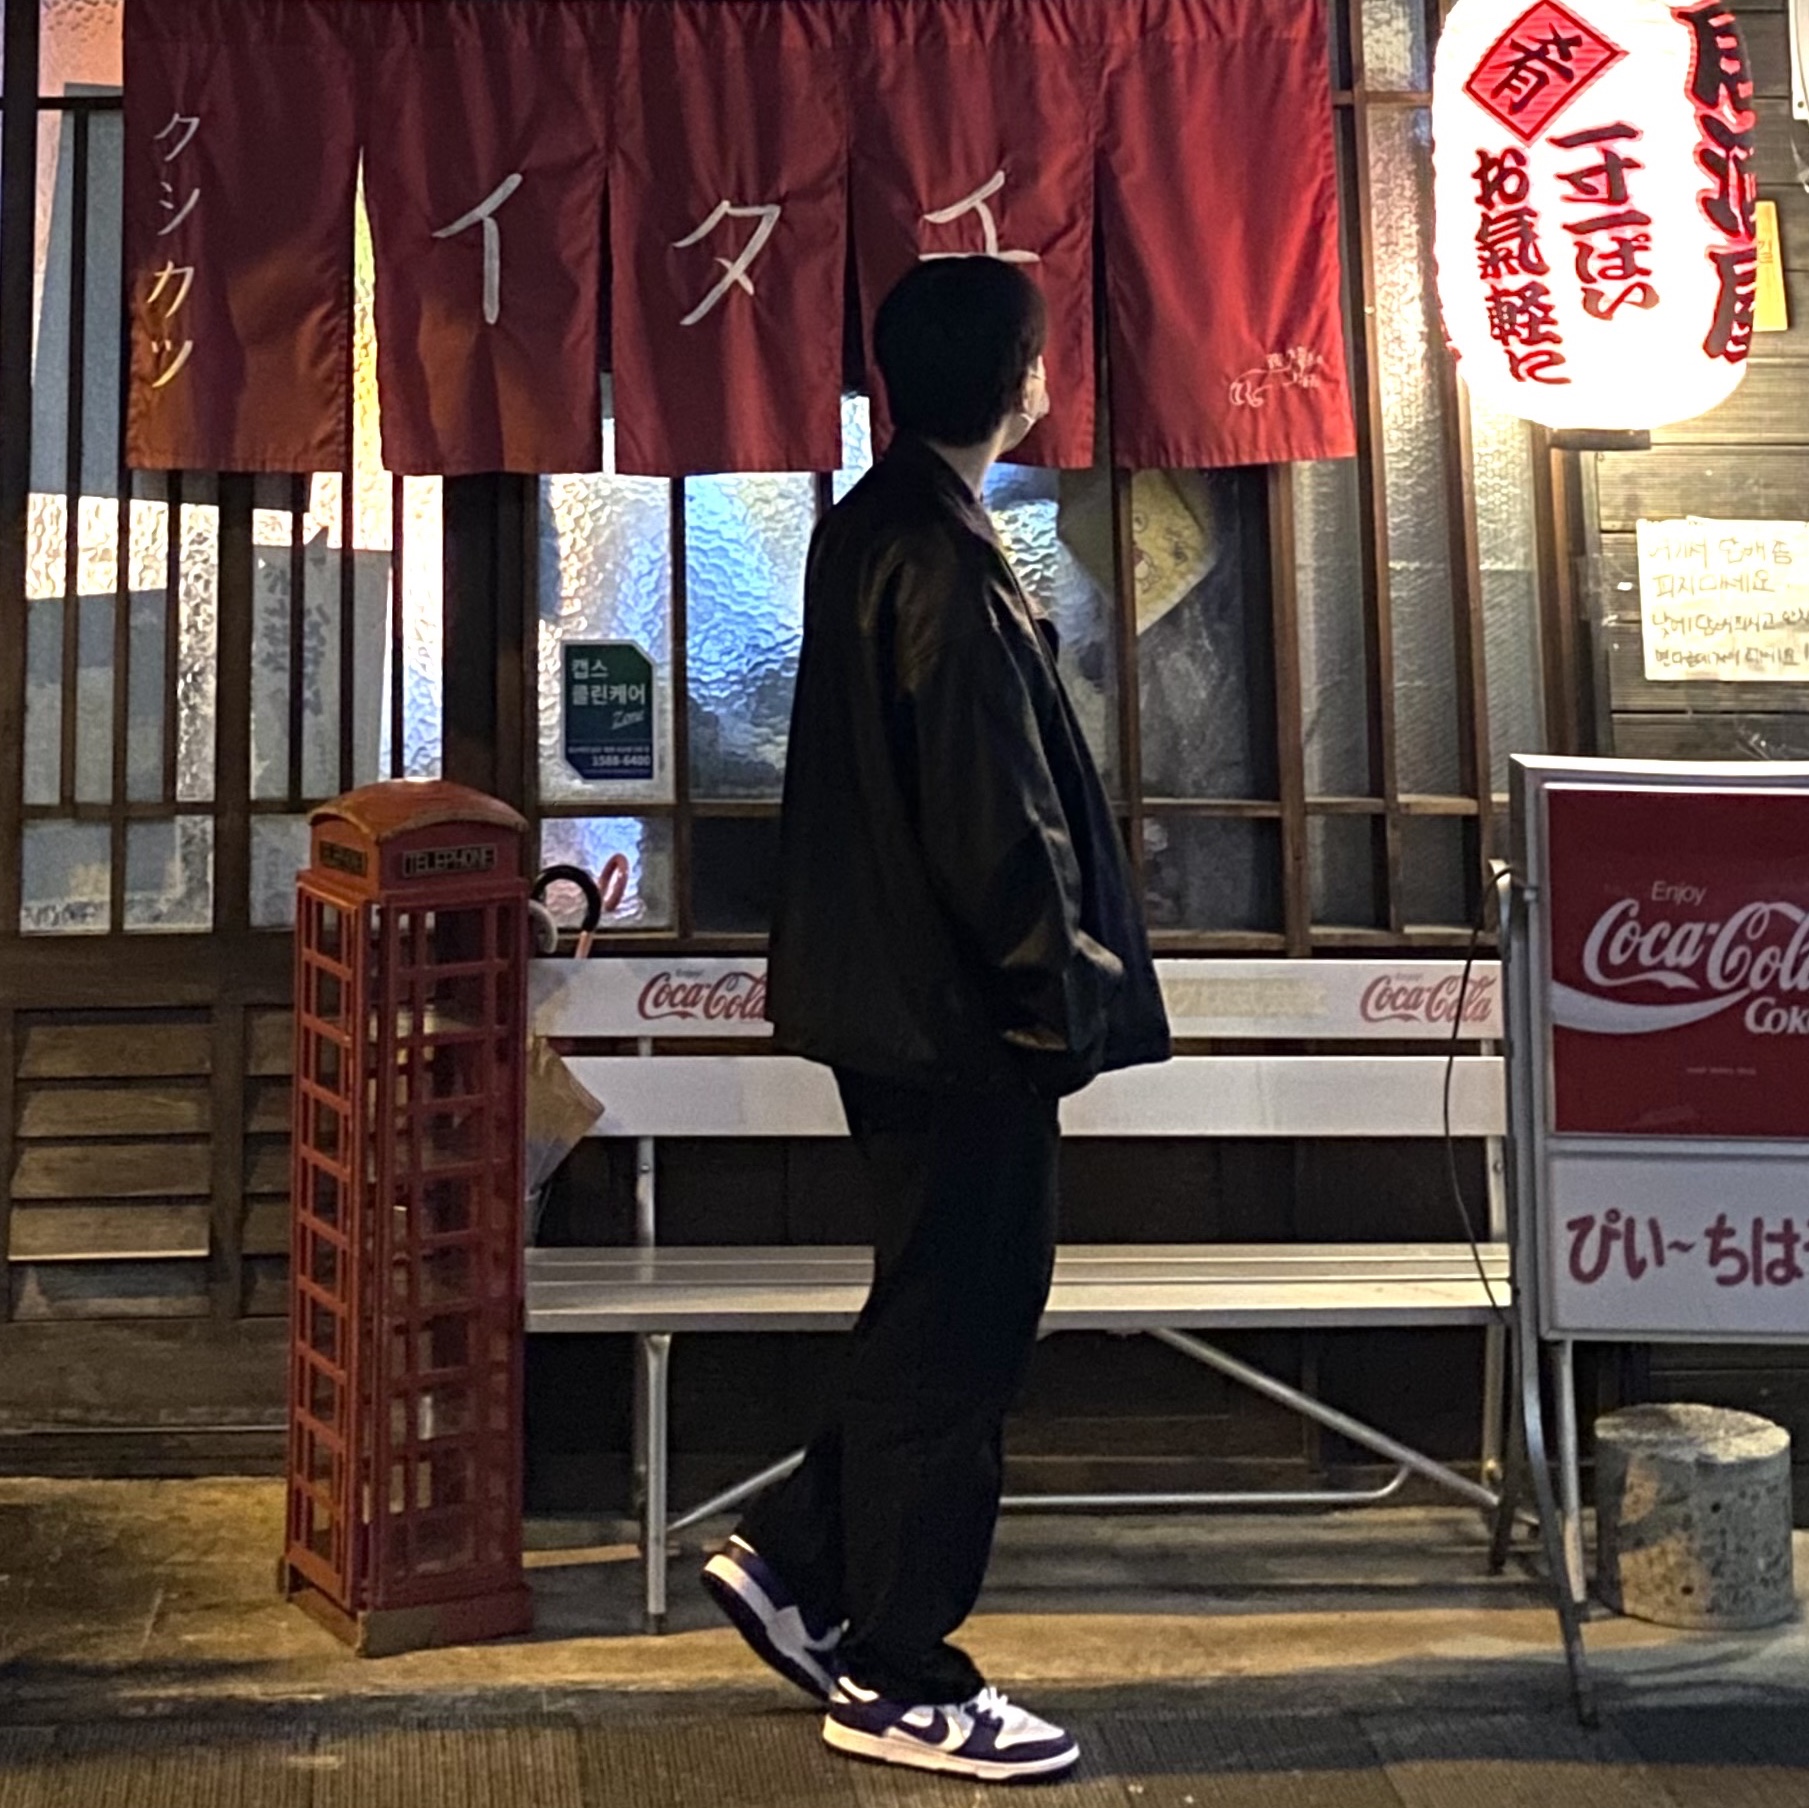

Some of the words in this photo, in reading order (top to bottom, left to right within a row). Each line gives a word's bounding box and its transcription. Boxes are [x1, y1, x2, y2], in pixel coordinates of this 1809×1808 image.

[1489, 21, 1583, 115] 肴
[147, 112, 200, 388] クシカツ
[572, 658, 609, 680] 캡스
[572, 683, 645, 706] 클린케어
[404, 845, 495, 876] TELEPHONE
[1651, 880, 1706, 906] Enjoy
[1360, 974, 1497, 1023] Coca-Cola
[1744, 996, 1809, 1034] Cok
